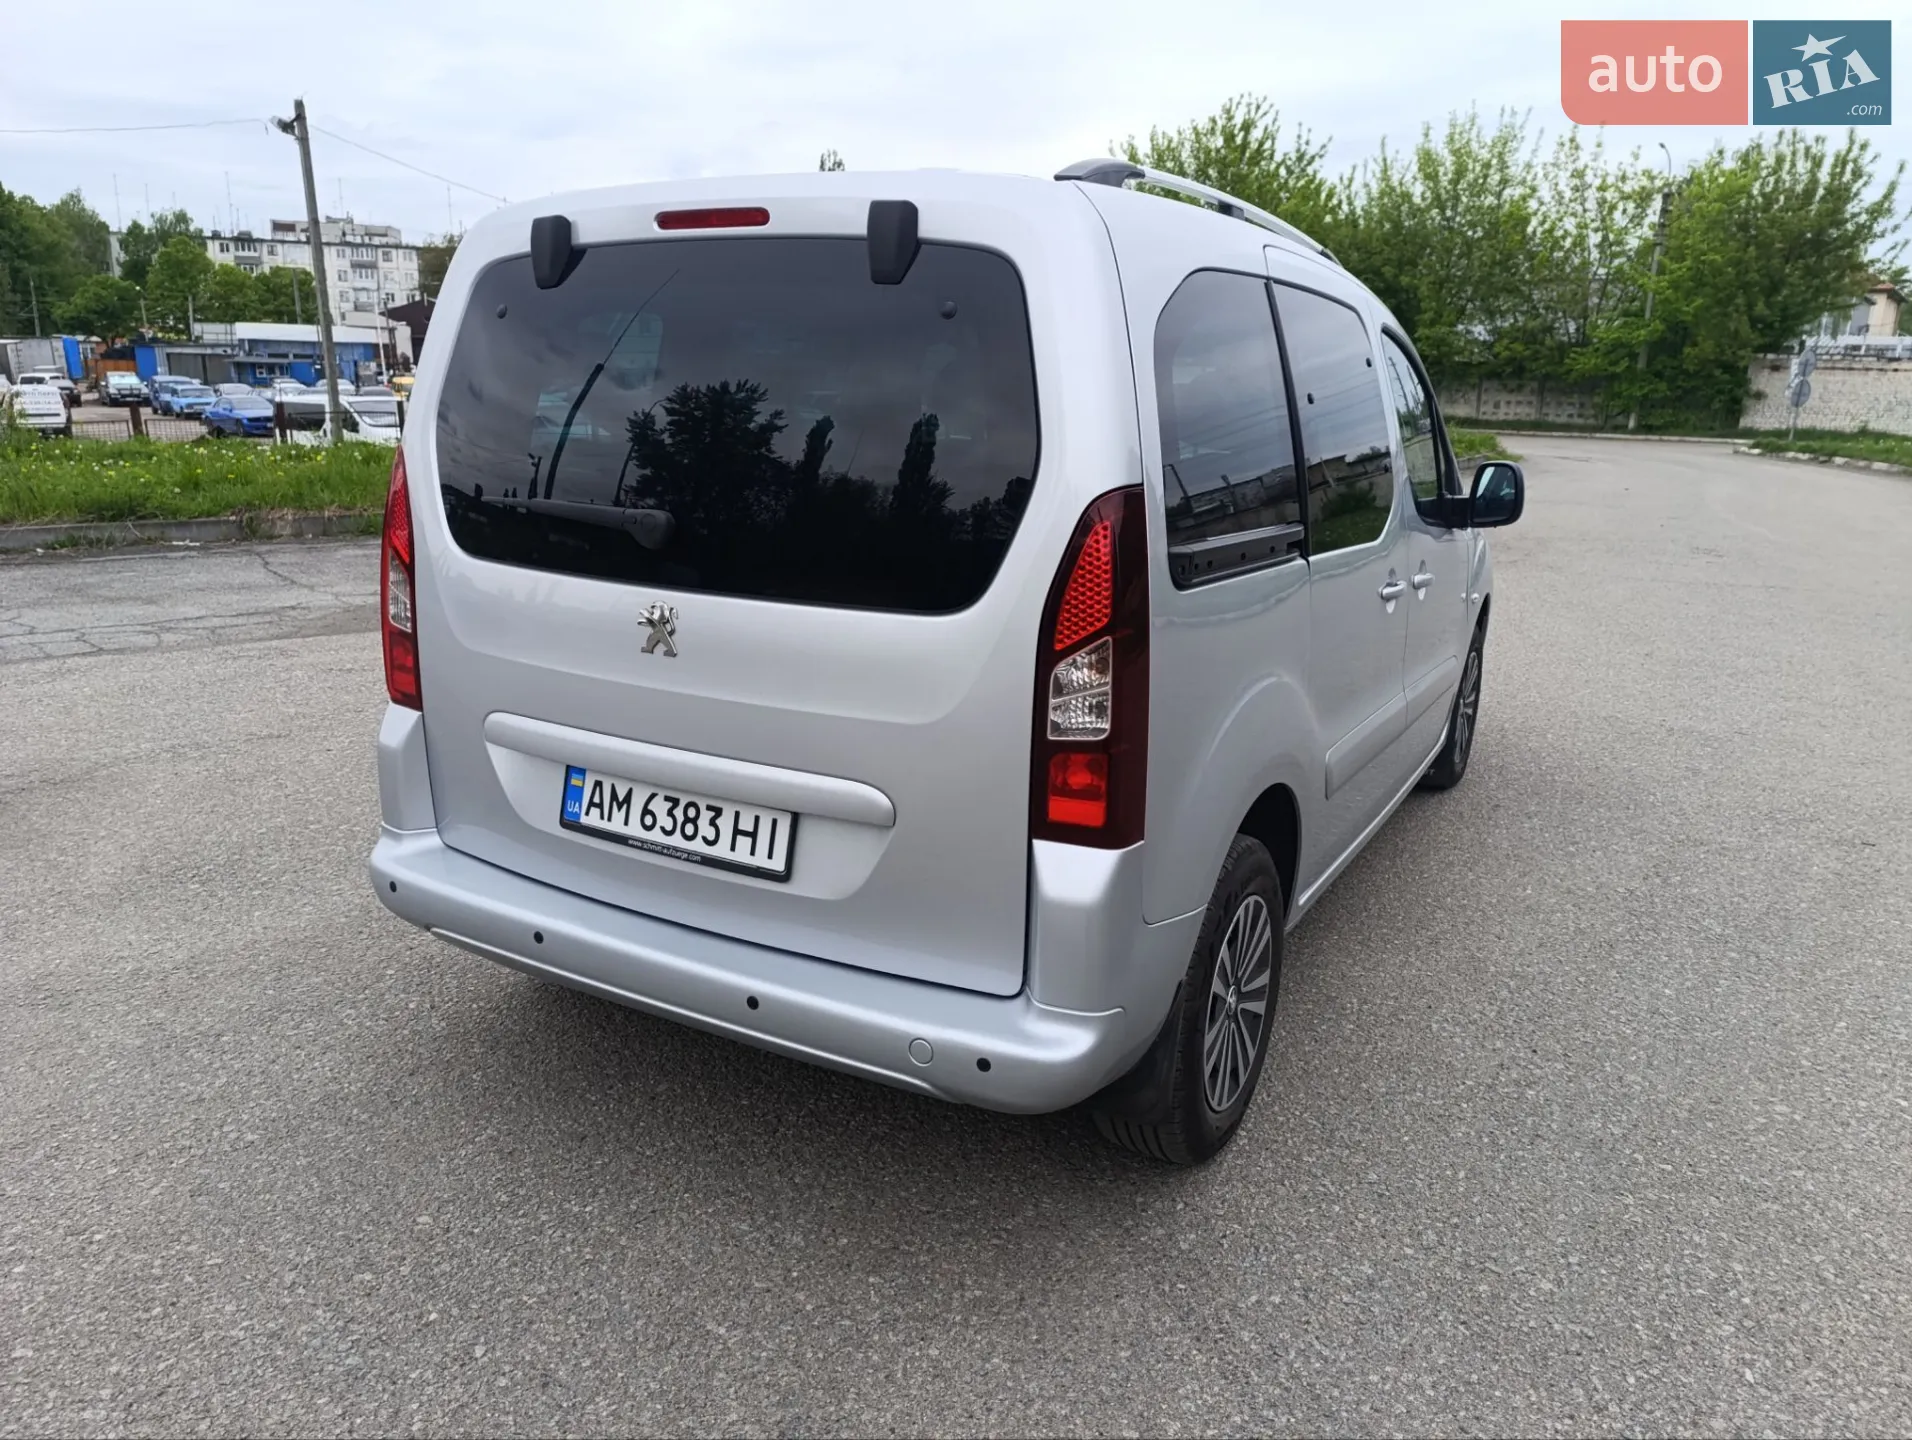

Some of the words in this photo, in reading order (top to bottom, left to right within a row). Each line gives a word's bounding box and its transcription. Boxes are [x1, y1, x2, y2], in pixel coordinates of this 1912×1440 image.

[567, 799, 580, 815] UA
[584, 779, 633, 827] AM
[640, 793, 723, 847] 6383
[729, 810, 778, 860] HI
